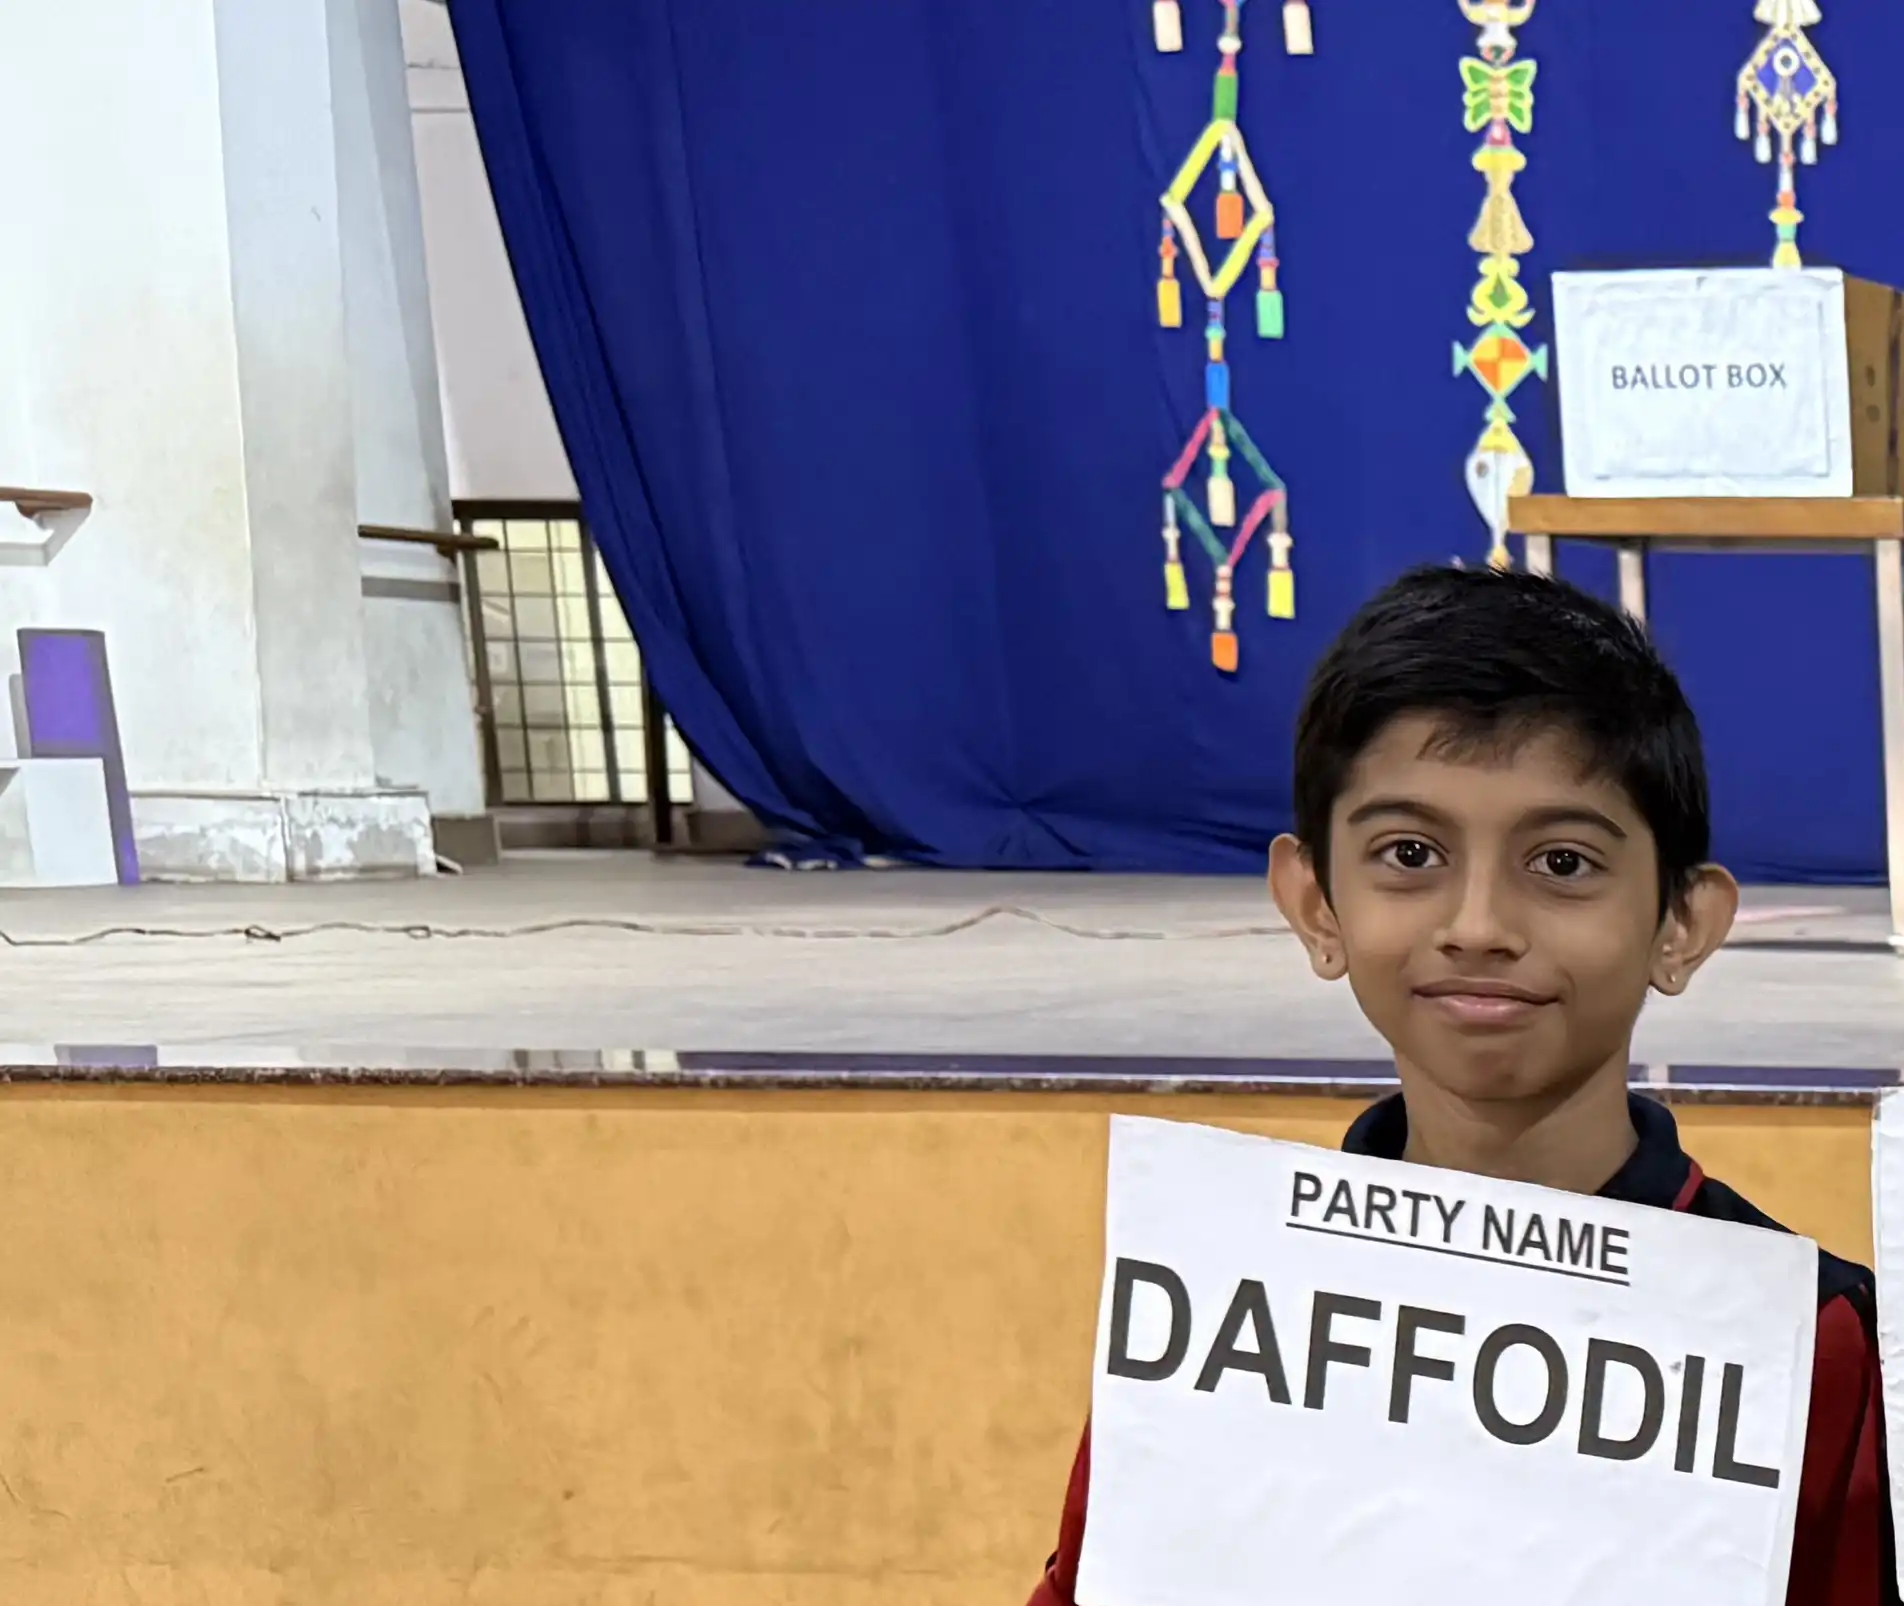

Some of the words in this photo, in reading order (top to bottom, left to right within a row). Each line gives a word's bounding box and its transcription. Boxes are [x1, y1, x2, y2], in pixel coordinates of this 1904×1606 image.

[1610, 364, 1717, 390] BALLOT
[1727, 363, 1787, 389] BOX
[1290, 1171, 1466, 1244] PARTY
[1481, 1204, 1630, 1276] NAME
[1106, 1257, 1781, 1490] DAFFODIL
